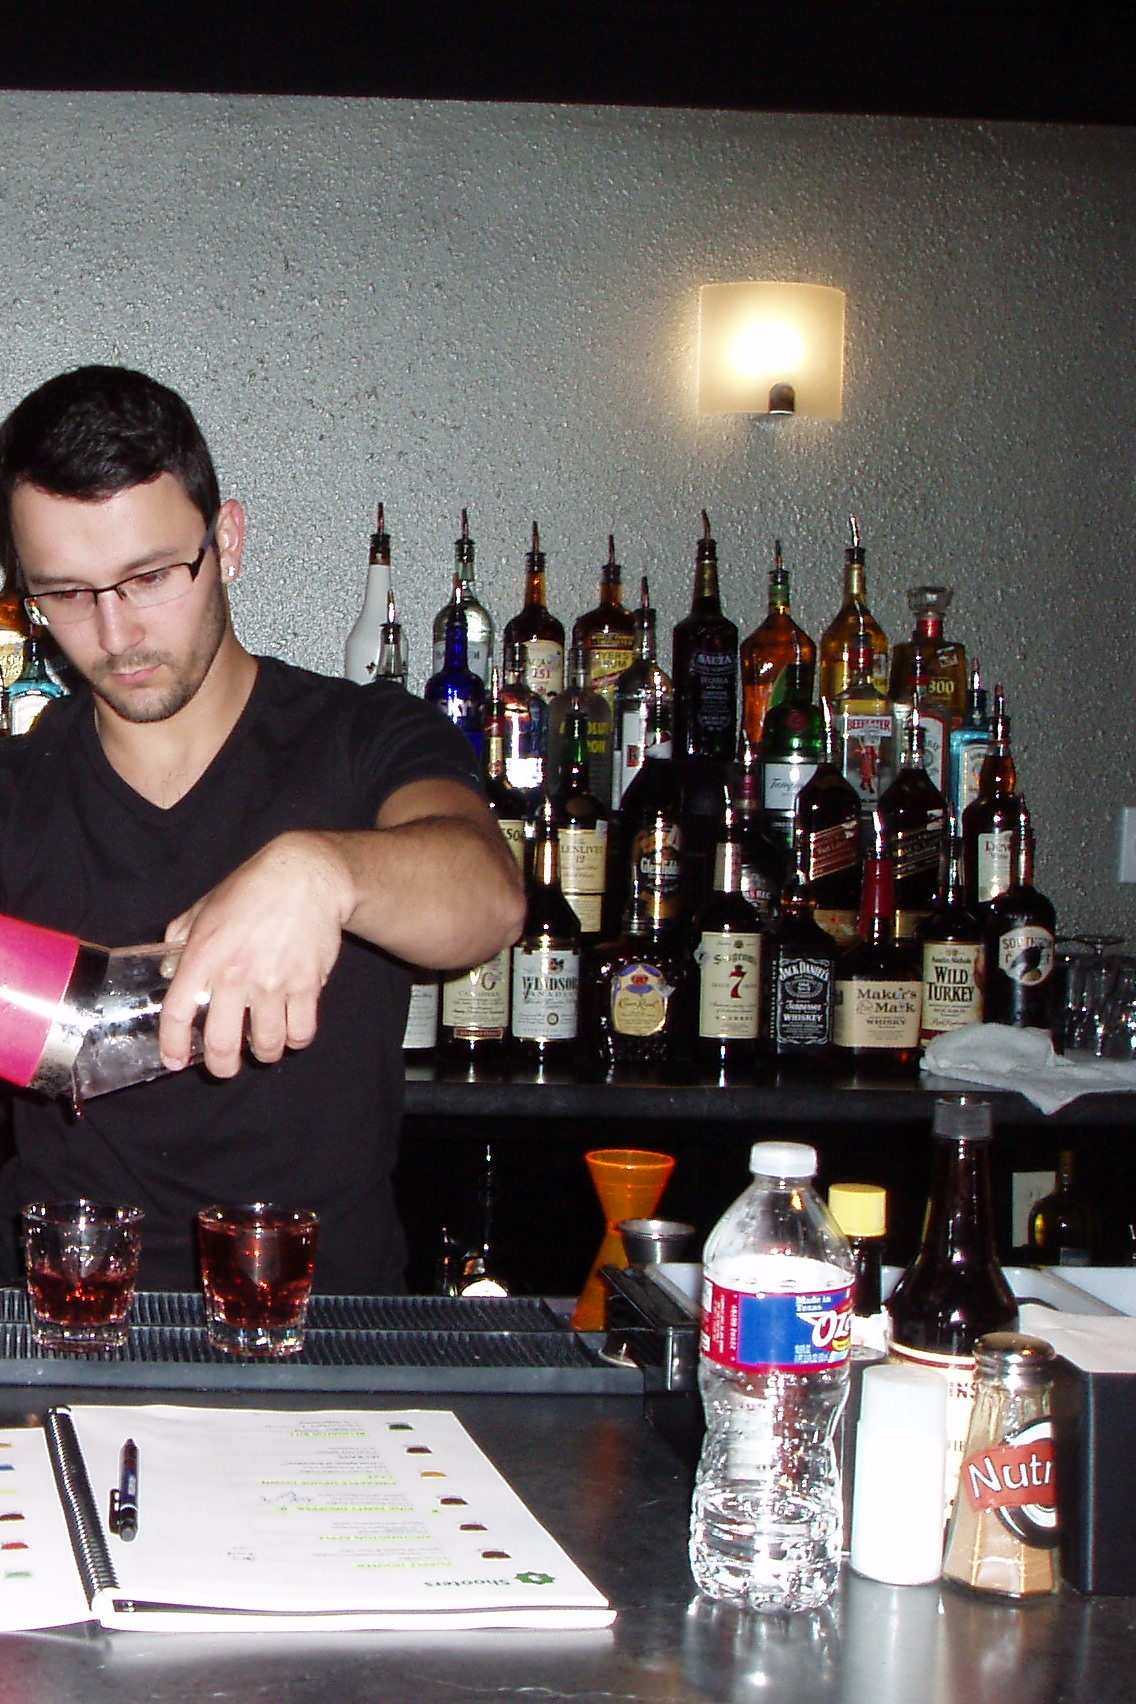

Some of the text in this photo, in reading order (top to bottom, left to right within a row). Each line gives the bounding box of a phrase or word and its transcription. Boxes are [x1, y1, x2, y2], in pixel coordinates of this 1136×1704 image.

[561, 844, 602, 855] LENLIVET
[778, 960, 830, 981] JACK DANIEL'S
[934, 966, 969, 985] WILD
[728, 971, 748, 999] 7
[857, 987, 918, 1001] Maker's
[927, 982, 975, 1003] TURKEY
[874, 1002, 917, 1014] Mark
[783, 1013, 824, 1022] WHISKEY
[424, 1575, 512, 1588] Shooters
